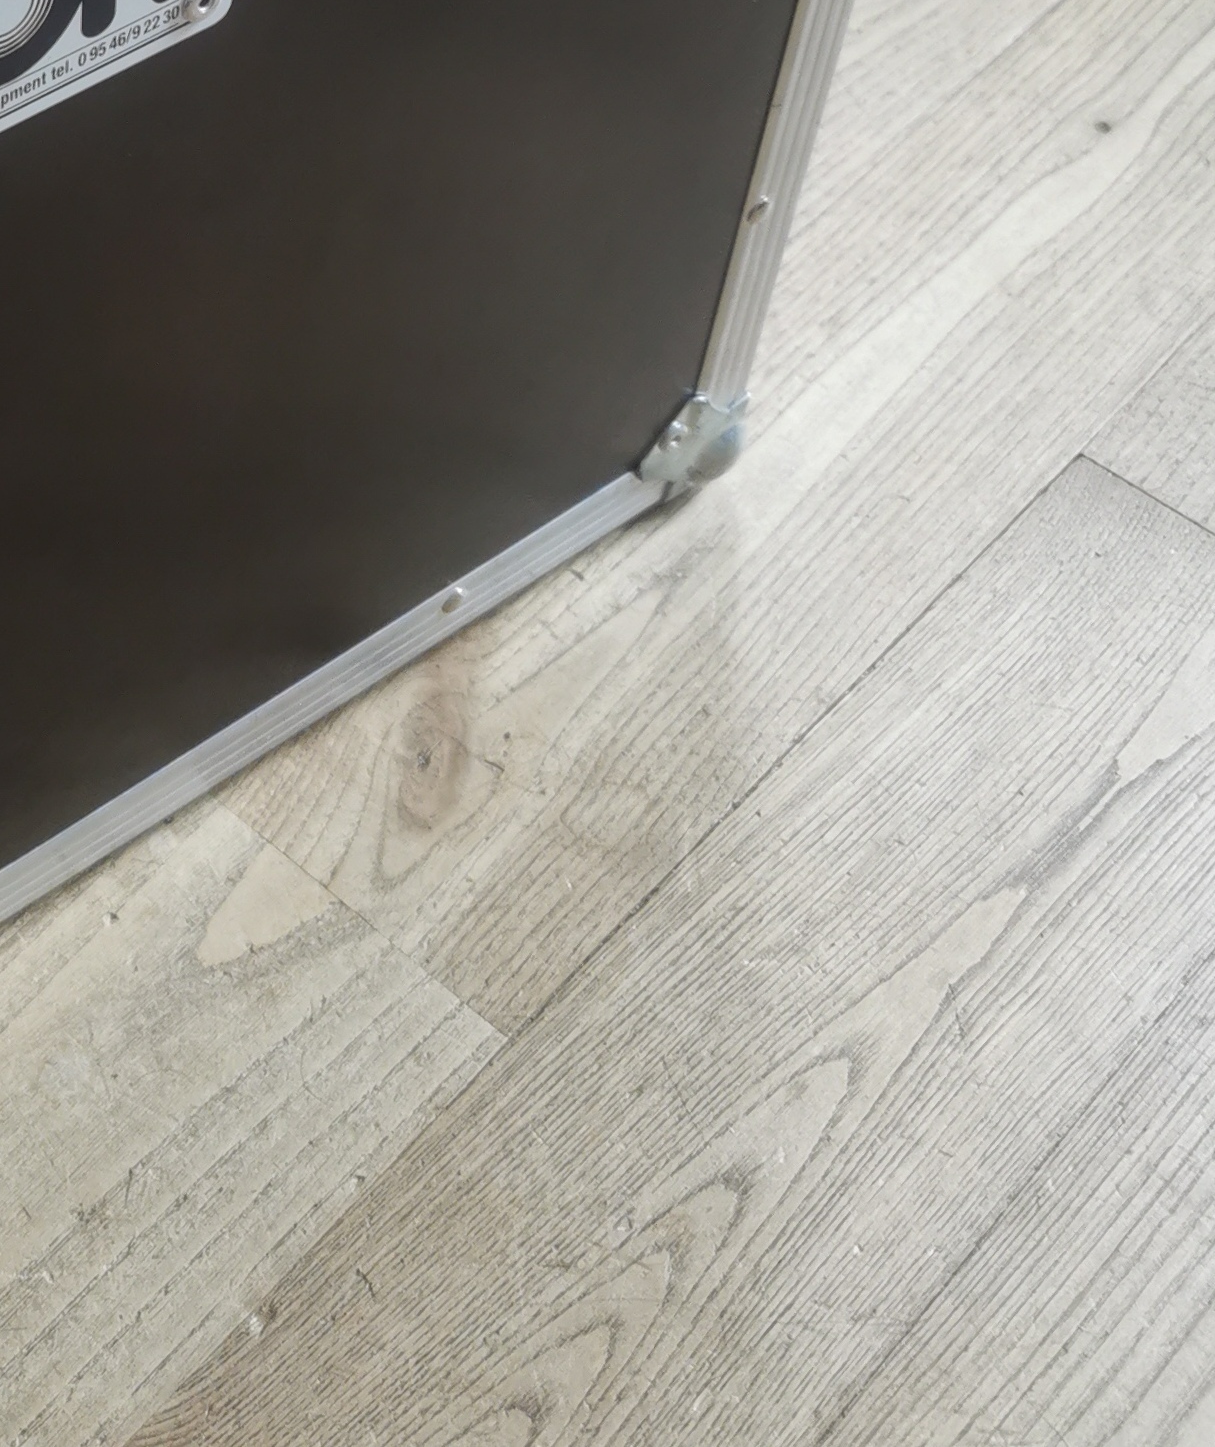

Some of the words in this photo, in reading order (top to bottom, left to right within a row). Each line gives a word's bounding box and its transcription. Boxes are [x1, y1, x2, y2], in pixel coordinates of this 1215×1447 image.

[51, 59, 74, 81] tel.
[78, 52, 87, 67] 0
[89, 42, 107, 62] 95
[108, 24, 141, 50] 46/9
[143, 15, 161, 34] 22
[162, 4, 180, 25] 30
